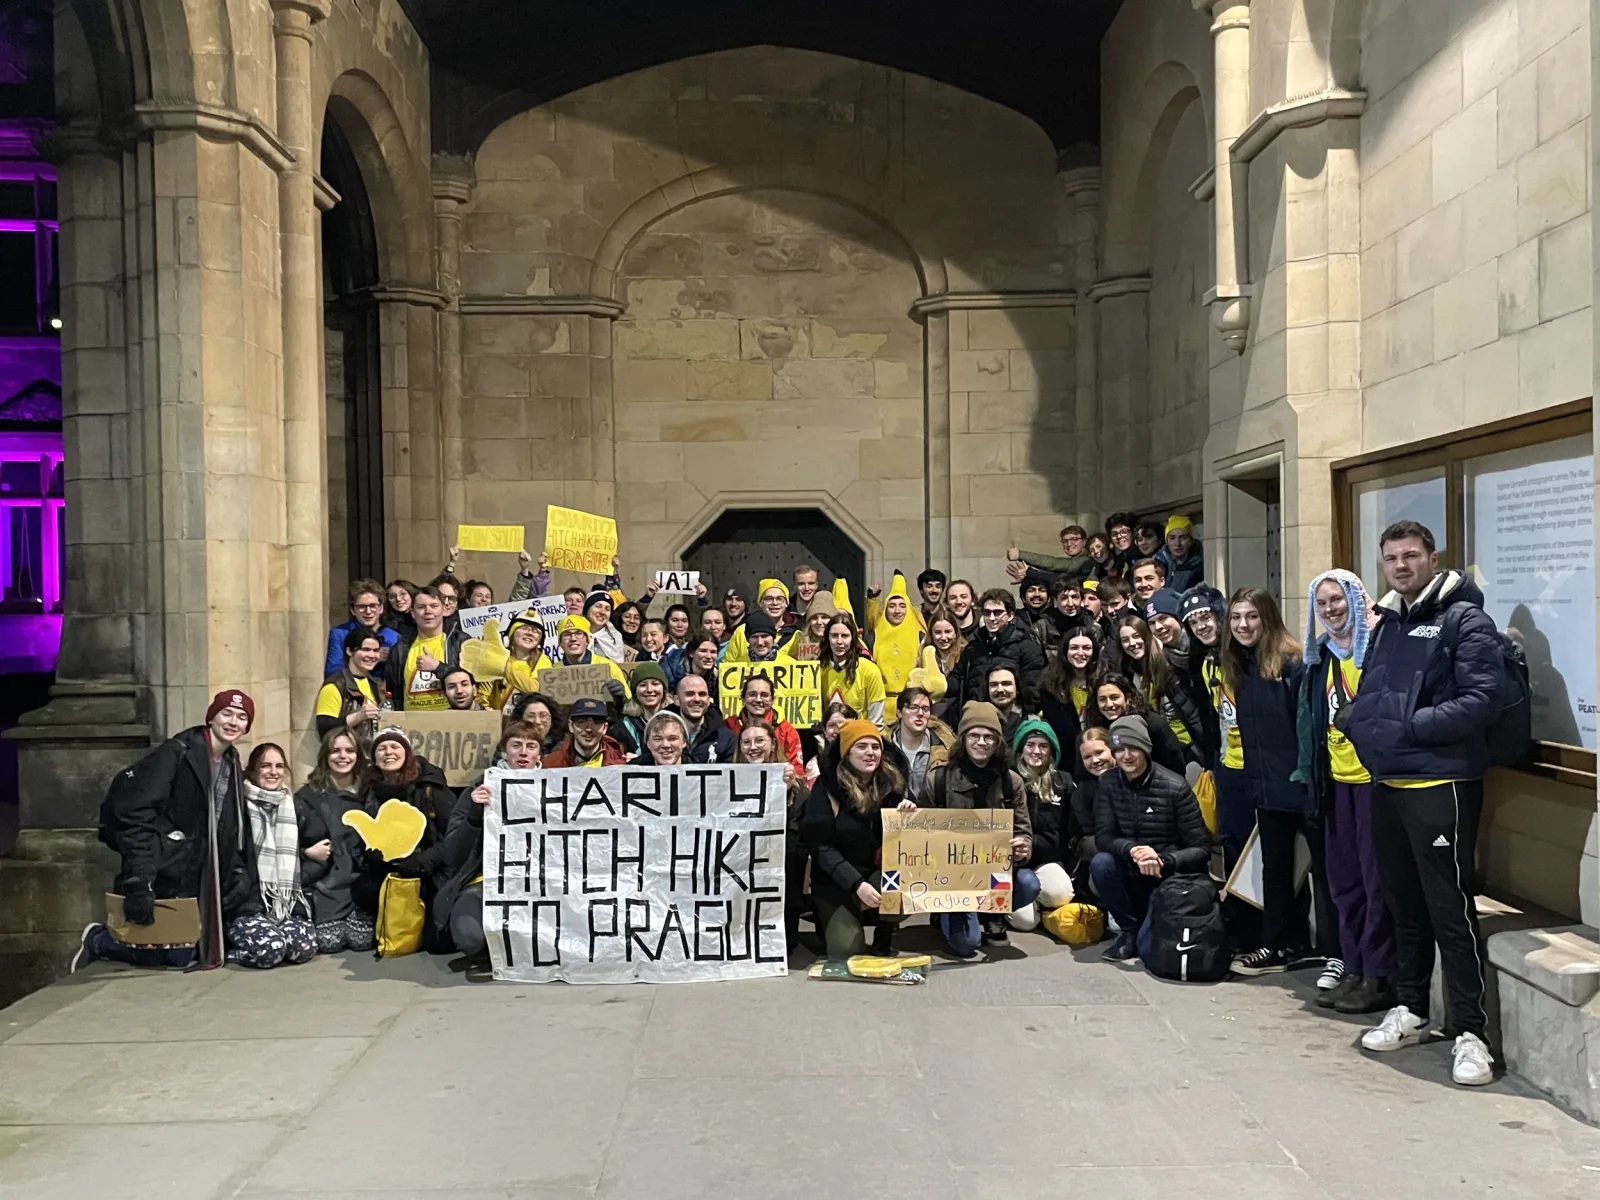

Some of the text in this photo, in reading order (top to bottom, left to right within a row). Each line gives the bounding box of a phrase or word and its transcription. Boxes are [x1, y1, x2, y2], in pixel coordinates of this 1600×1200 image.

[548, 529, 616, 550] HITCHHIKE TO
[552, 548, 609, 573] PRAGUE
[536, 604, 566, 615] NDREWS
[408, 729, 491, 771] RANCE
[501, 769, 767, 825] CHARITY
[498, 826, 784, 897] HITCH HIKE
[934, 873, 949, 886] to
[485, 896, 784, 967] TO PRAGUE
